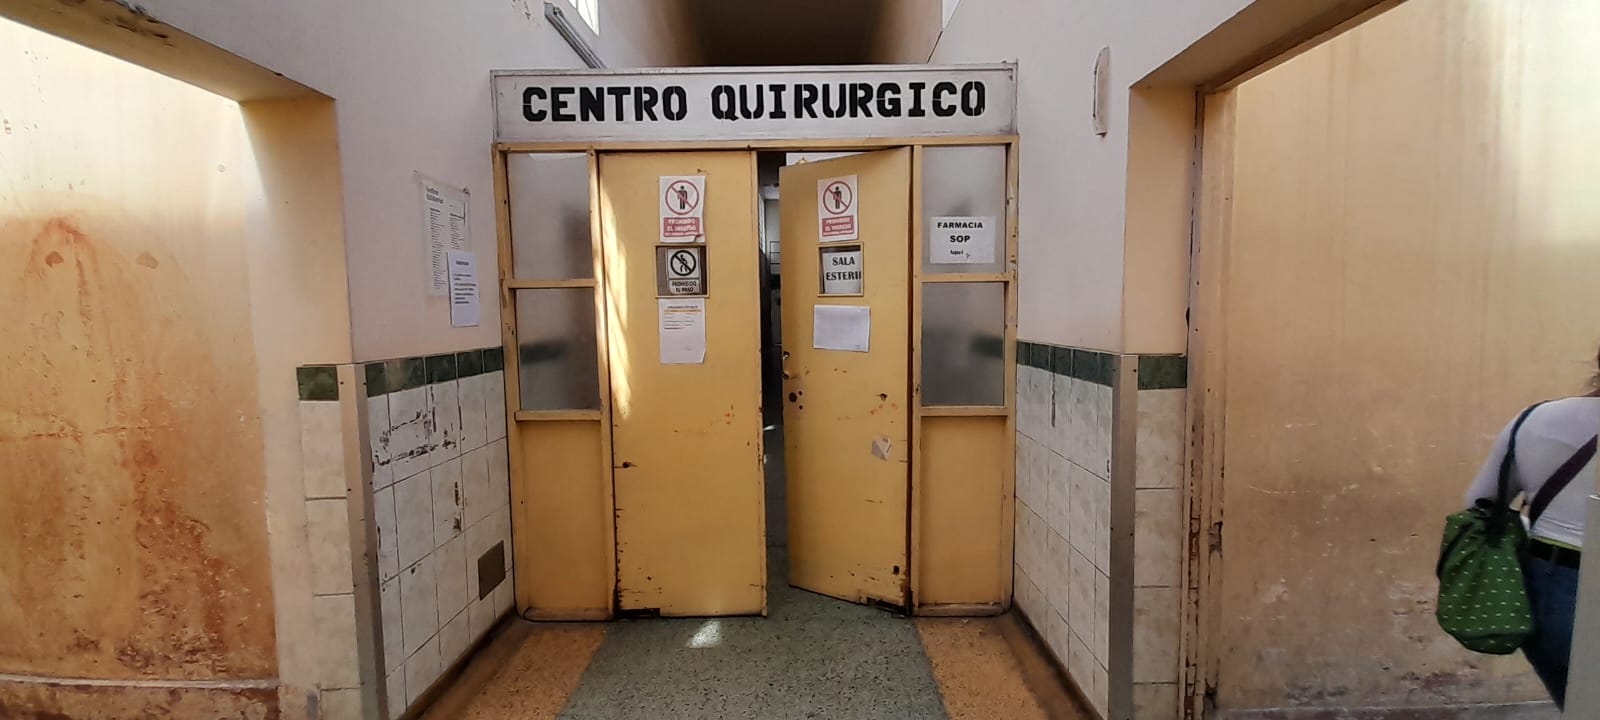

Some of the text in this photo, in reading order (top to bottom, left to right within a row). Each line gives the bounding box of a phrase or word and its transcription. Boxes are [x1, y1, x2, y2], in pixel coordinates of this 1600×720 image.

[522, 81, 985, 122] CENTRO QUIRURGICO
[937, 221, 984, 229] FARMACIA
[949, 234, 971, 243] SOP
[831, 256, 856, 267] SALA
